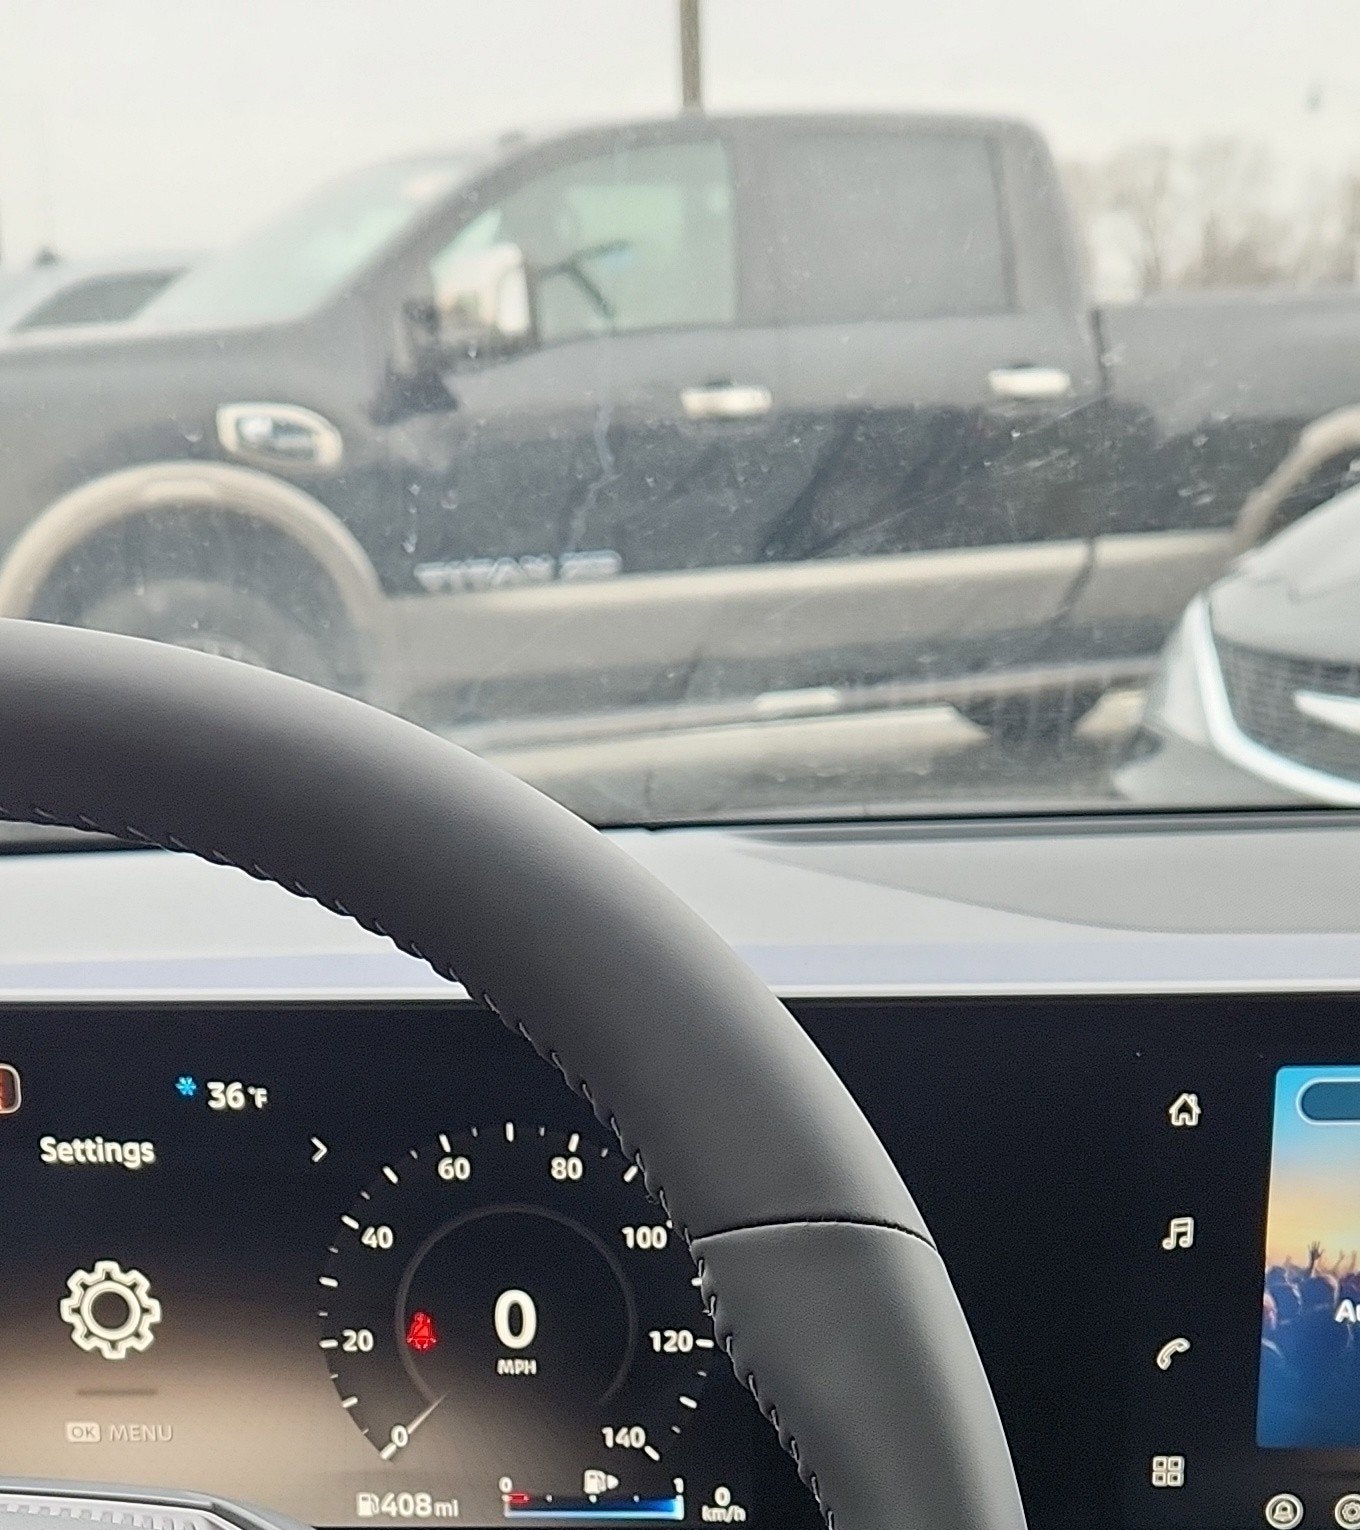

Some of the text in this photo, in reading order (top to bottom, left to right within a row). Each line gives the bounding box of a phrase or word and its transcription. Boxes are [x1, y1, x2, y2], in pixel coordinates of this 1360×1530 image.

[40, 1135, 157, 1169] Settings
[439, 1157, 471, 1180] 60
[551, 1157, 583, 1180] 80
[362, 1226, 394, 1250] 40
[622, 1226, 668, 1250] 100
[495, 1289, 537, 1349] 0
[342, 1330, 374, 1352] 20
[649, 1330, 694, 1352] 120
[498, 1359, 537, 1376] MPH
[72, 1424, 173, 1442] OK MENU
[391, 1426, 408, 1448] 0
[602, 1426, 646, 1449] 140
[499, 1477, 513, 1492] 0
[673, 1477, 684, 1493] 1
[715, 1487, 731, 1506] 0
[702, 1505, 747, 1523] km/h
